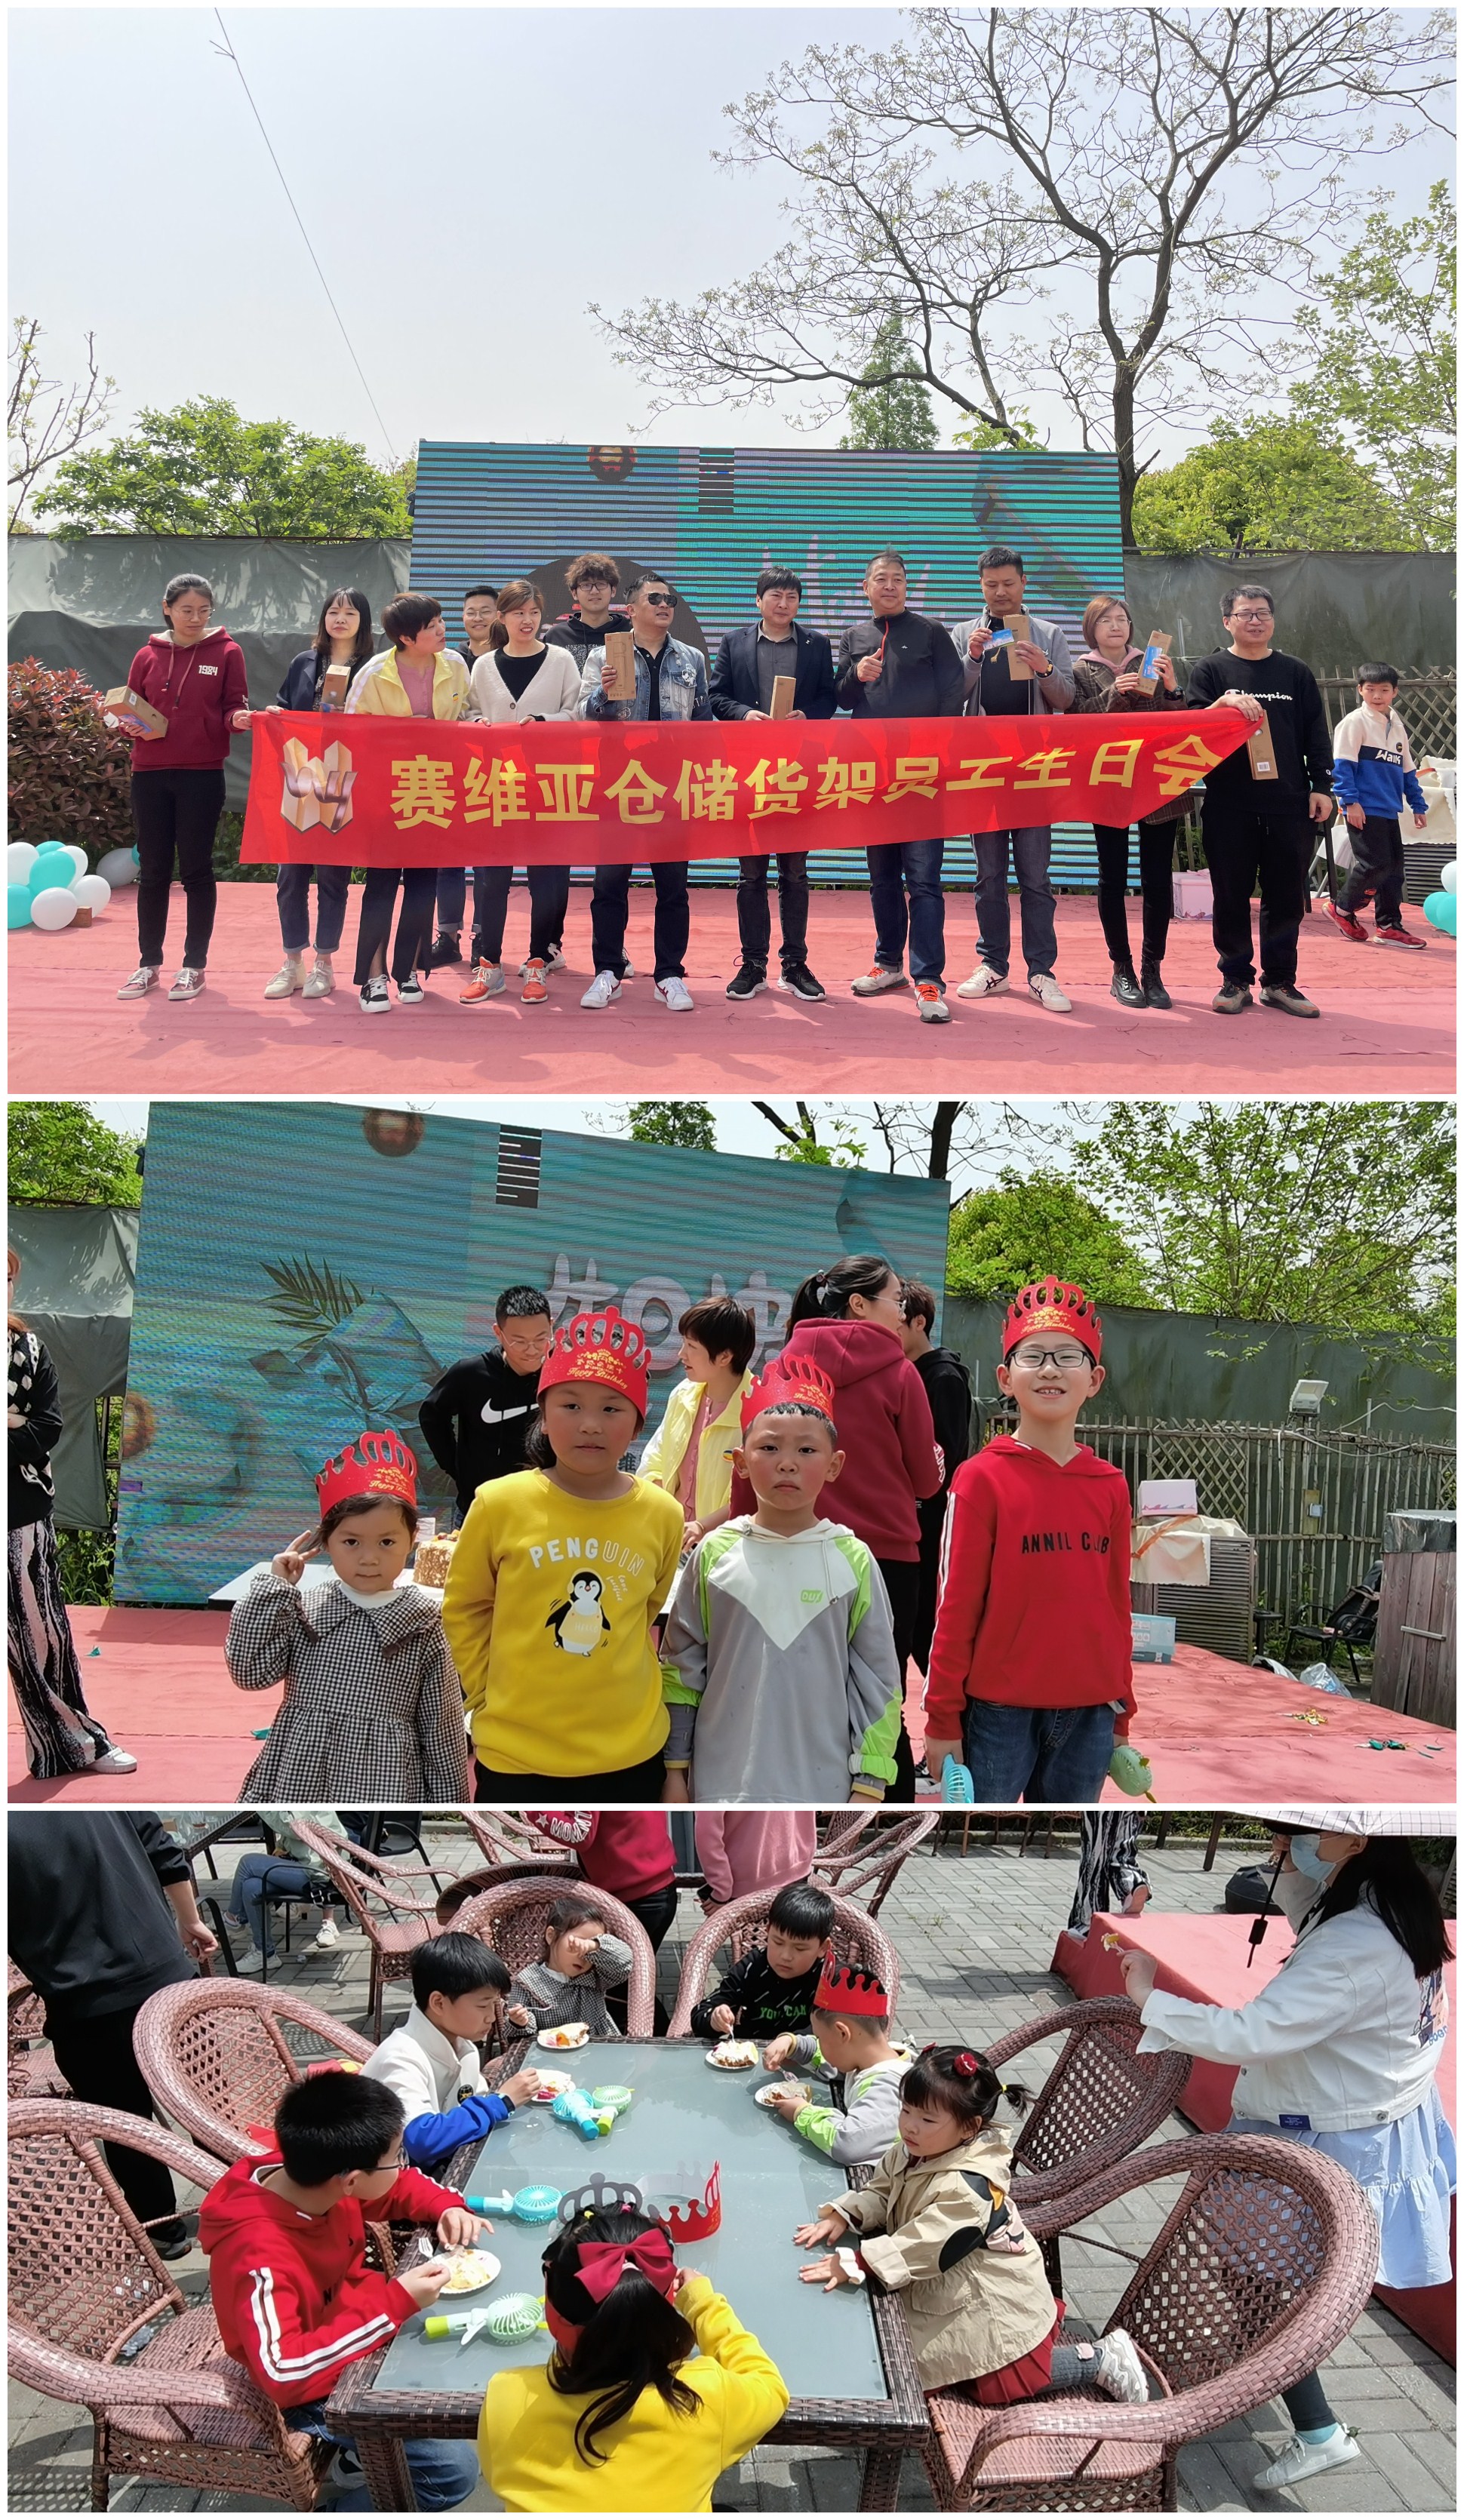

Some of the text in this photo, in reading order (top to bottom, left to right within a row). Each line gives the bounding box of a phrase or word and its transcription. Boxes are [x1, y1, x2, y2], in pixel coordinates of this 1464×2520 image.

[198, 665, 218, 676] 1984
[1375, 749, 1401, 764] Walk
[390, 734, 1224, 829] 赛维亚仓储货架员工生日会
[567, 1367, 628, 1389] Happy Birthday
[1022, 1532, 1072, 1554] ANNIL
[529, 1537, 644, 1577] PENGUIN
[550, 1811, 592, 1843] MOMNT
[785, 2005, 806, 2017] CAN
